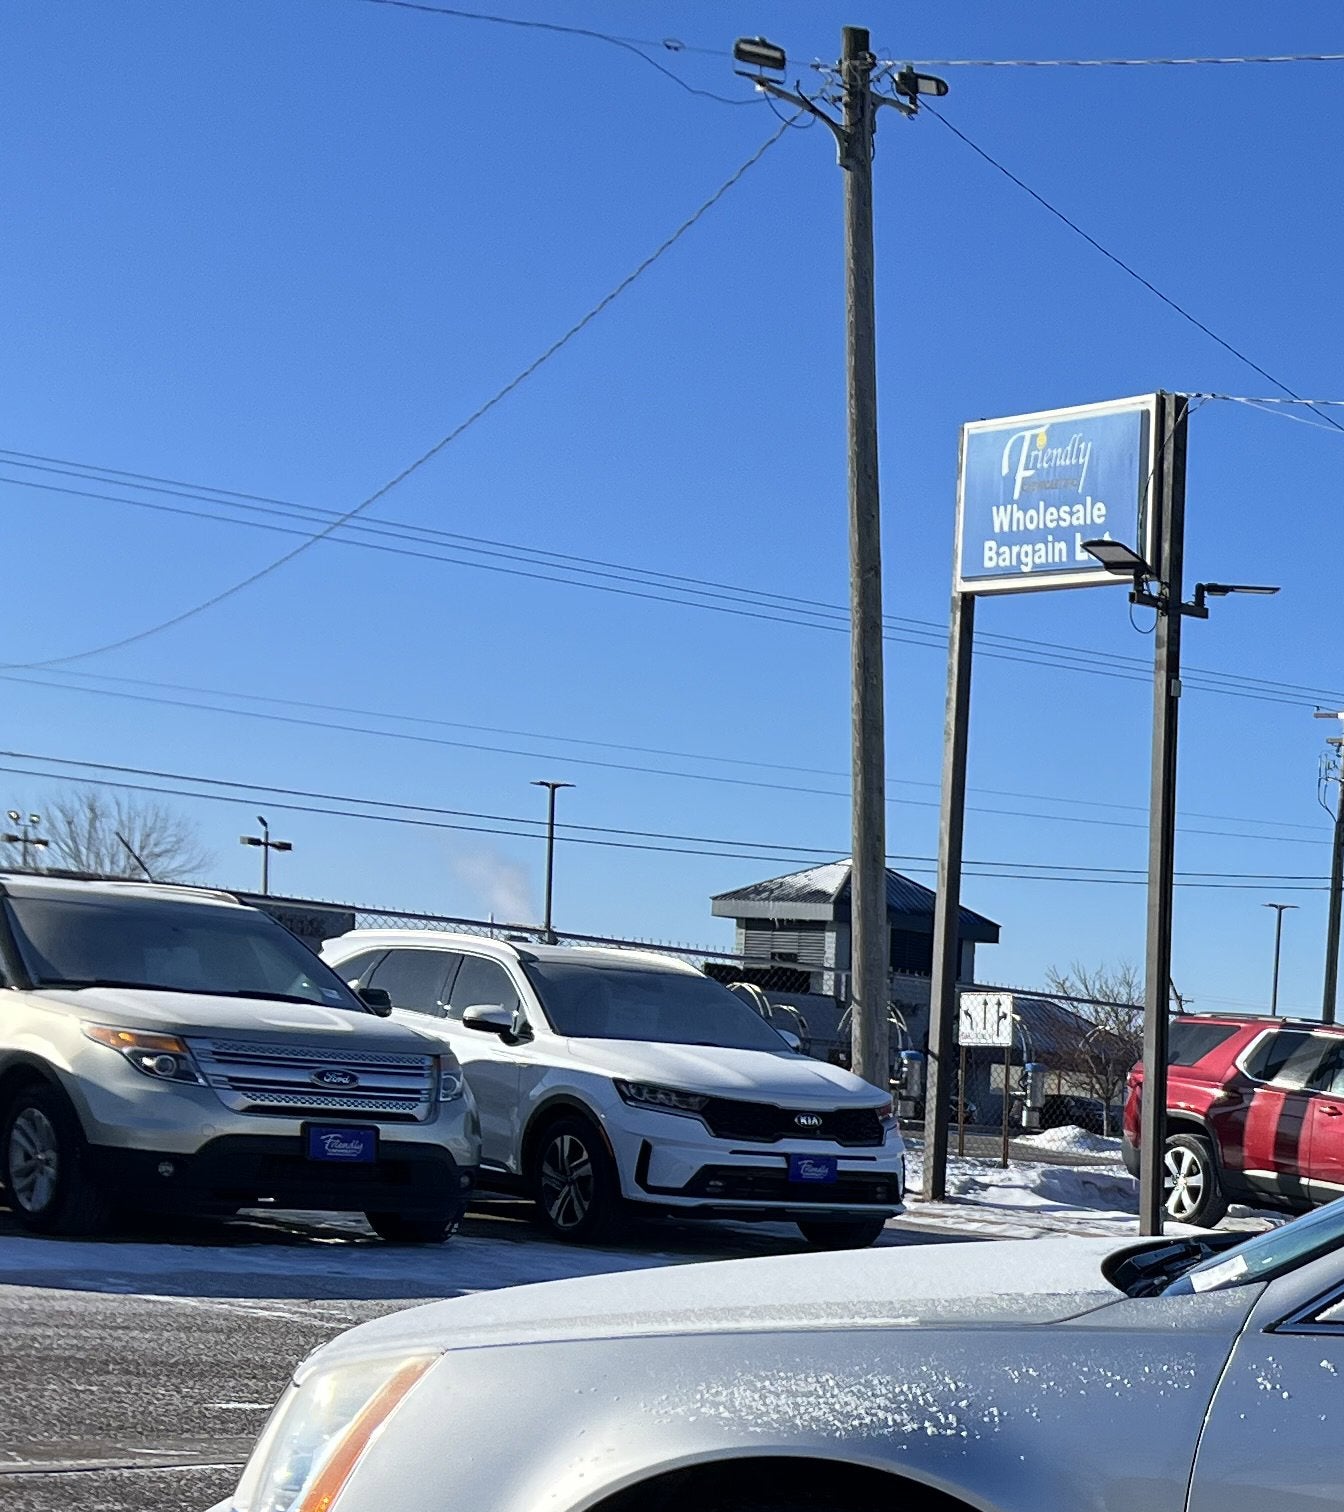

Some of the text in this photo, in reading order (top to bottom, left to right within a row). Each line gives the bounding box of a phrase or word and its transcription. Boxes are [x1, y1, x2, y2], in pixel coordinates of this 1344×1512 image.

[1002, 424, 1092, 500] Friendly
[992, 496, 1107, 533] Wholesale
[983, 535, 1067, 573] Bargain
[323, 1071, 351, 1084] Ford
[800, 1116, 819, 1125] KIA
